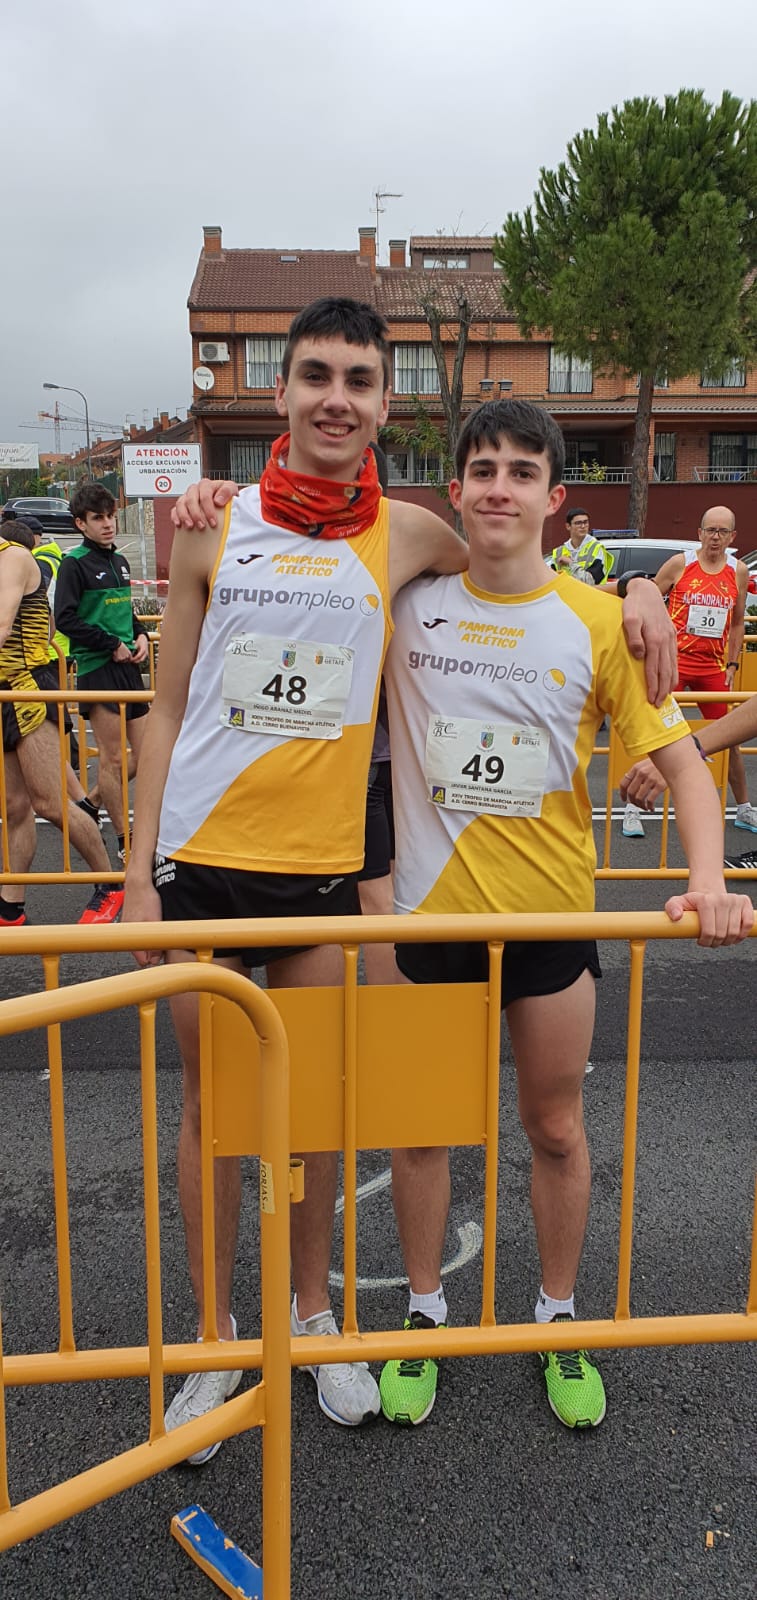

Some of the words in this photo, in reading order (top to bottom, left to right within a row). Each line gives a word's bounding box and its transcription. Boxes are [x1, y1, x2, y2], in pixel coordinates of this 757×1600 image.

[136, 448, 188, 457] ATENCIÓN
[271, 553, 340, 568] PAMPLONA
[275, 564, 333, 577] ATLÉTICO
[219, 587, 355, 611] grupompleo
[457, 620, 526, 638] PAMPLONA
[700, 616, 716, 627] 30
[461, 632, 518, 649] ATLÉTICO
[408, 650, 538, 684] grupompleo
[262, 673, 307, 706] 48
[461, 753, 505, 785] 49
